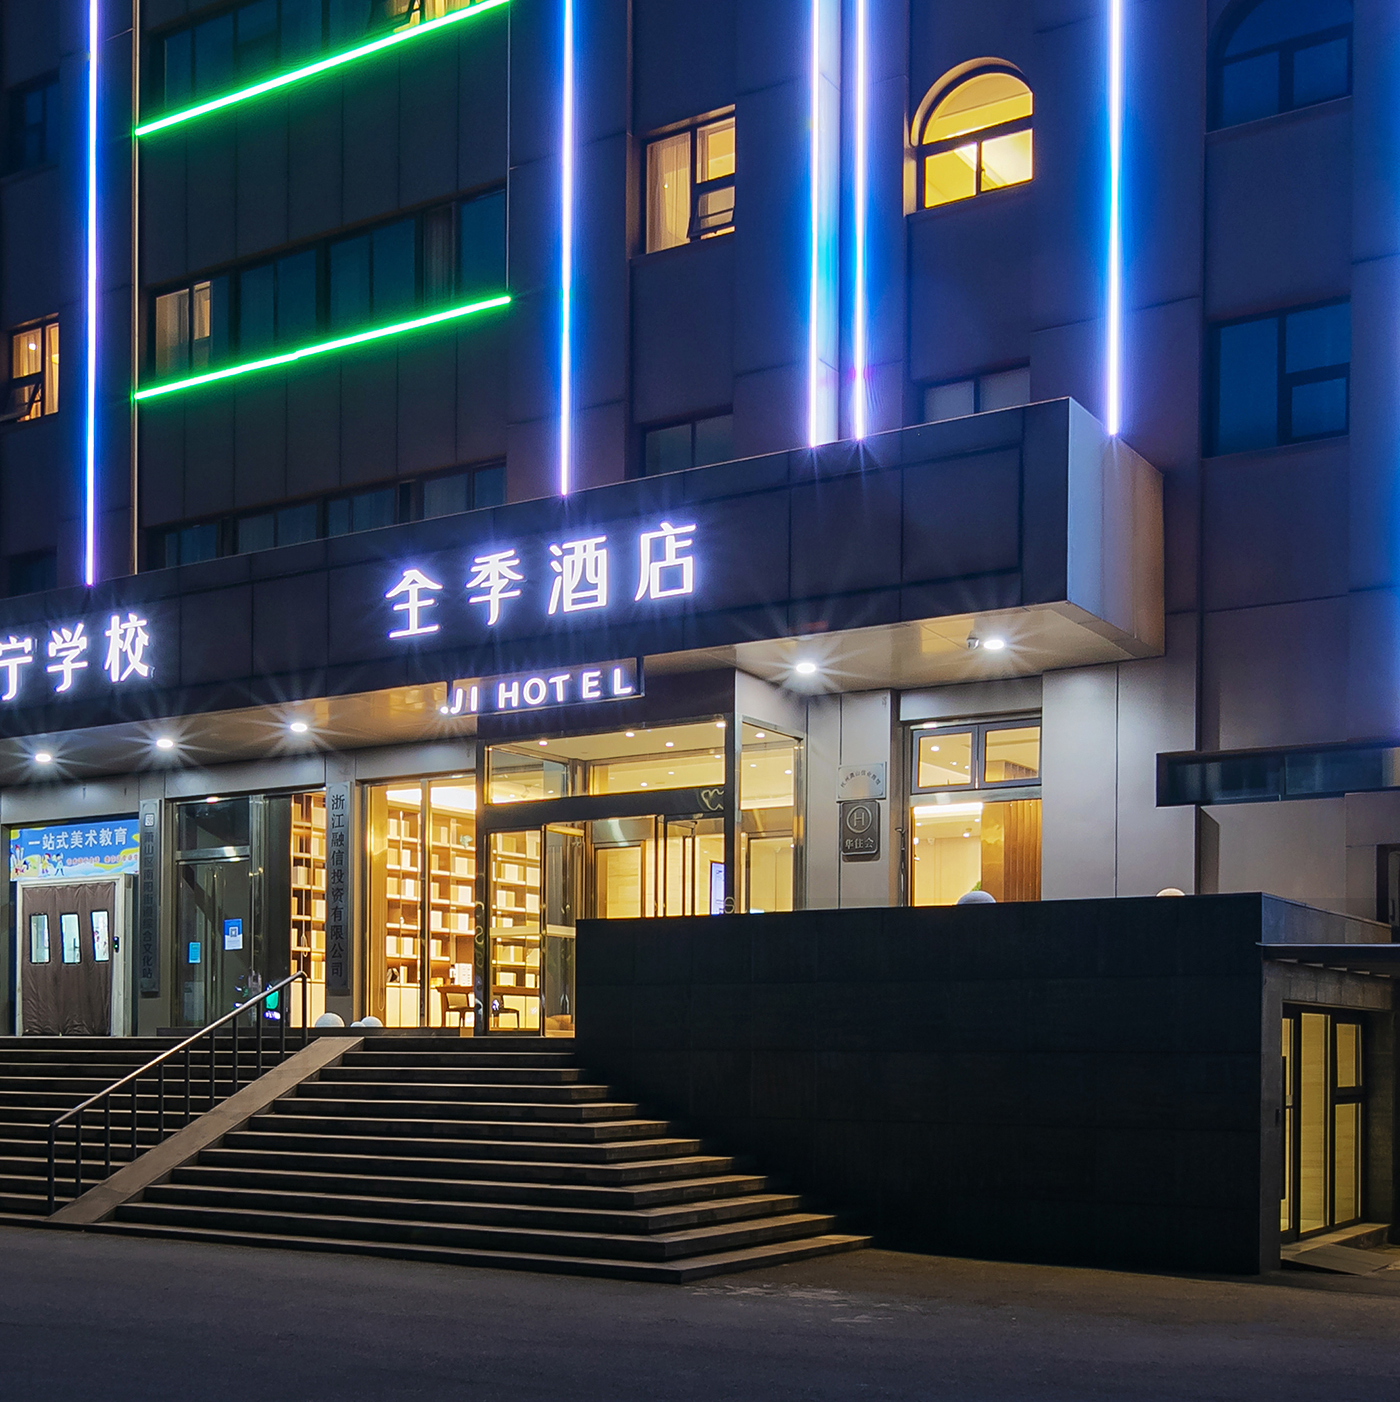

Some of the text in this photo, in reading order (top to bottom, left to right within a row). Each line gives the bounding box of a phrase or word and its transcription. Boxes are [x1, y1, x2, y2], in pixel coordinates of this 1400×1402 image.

[385, 521, 697, 640] 全季酒店
[450, 668, 632, 715] JI HOTEL
[28, 826, 128, 851] 一站式美术教育
[329, 793, 345, 978] 浙江融信投资有限公司
